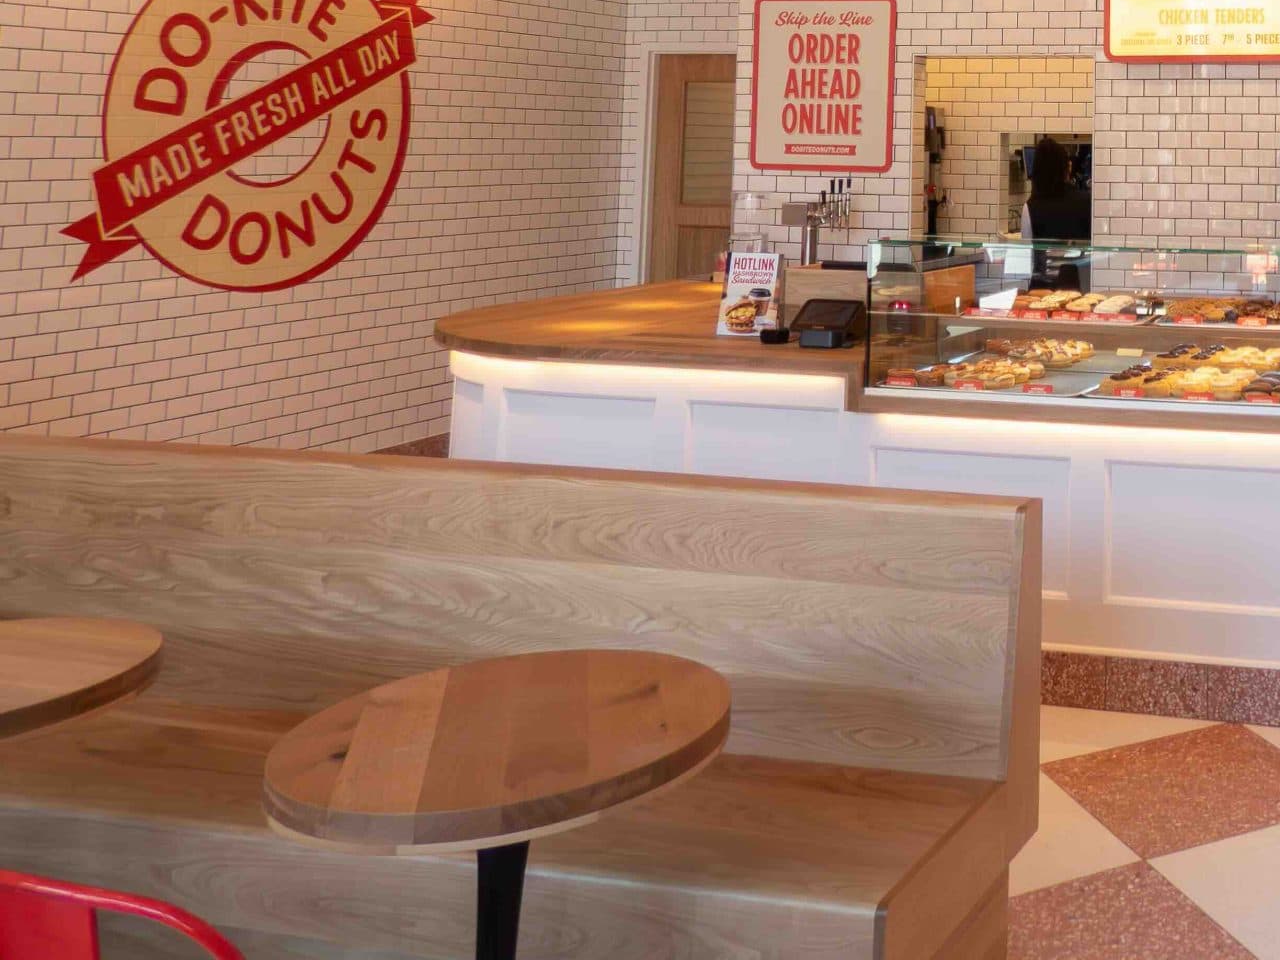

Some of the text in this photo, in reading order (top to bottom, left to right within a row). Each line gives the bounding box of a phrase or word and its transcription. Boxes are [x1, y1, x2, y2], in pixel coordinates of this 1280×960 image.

[774, 11, 874, 29] Skip the Line
[1158, 7, 1266, 25] CHICKEN TENDERS
[788, 33, 861, 65] ORDER
[1176, 34, 1183, 45] 3
[1185, 33, 1210, 45] PIECE
[1255, 33, 1280, 44] PIECE
[784, 68, 862, 100] AHEAD
[117, 29, 402, 208] MADE FRESH ALL DAY
[781, 102, 863, 135] ONLINE
[180, 107, 388, 266] DONUTS
[734, 257, 776, 271] HOTLINK
